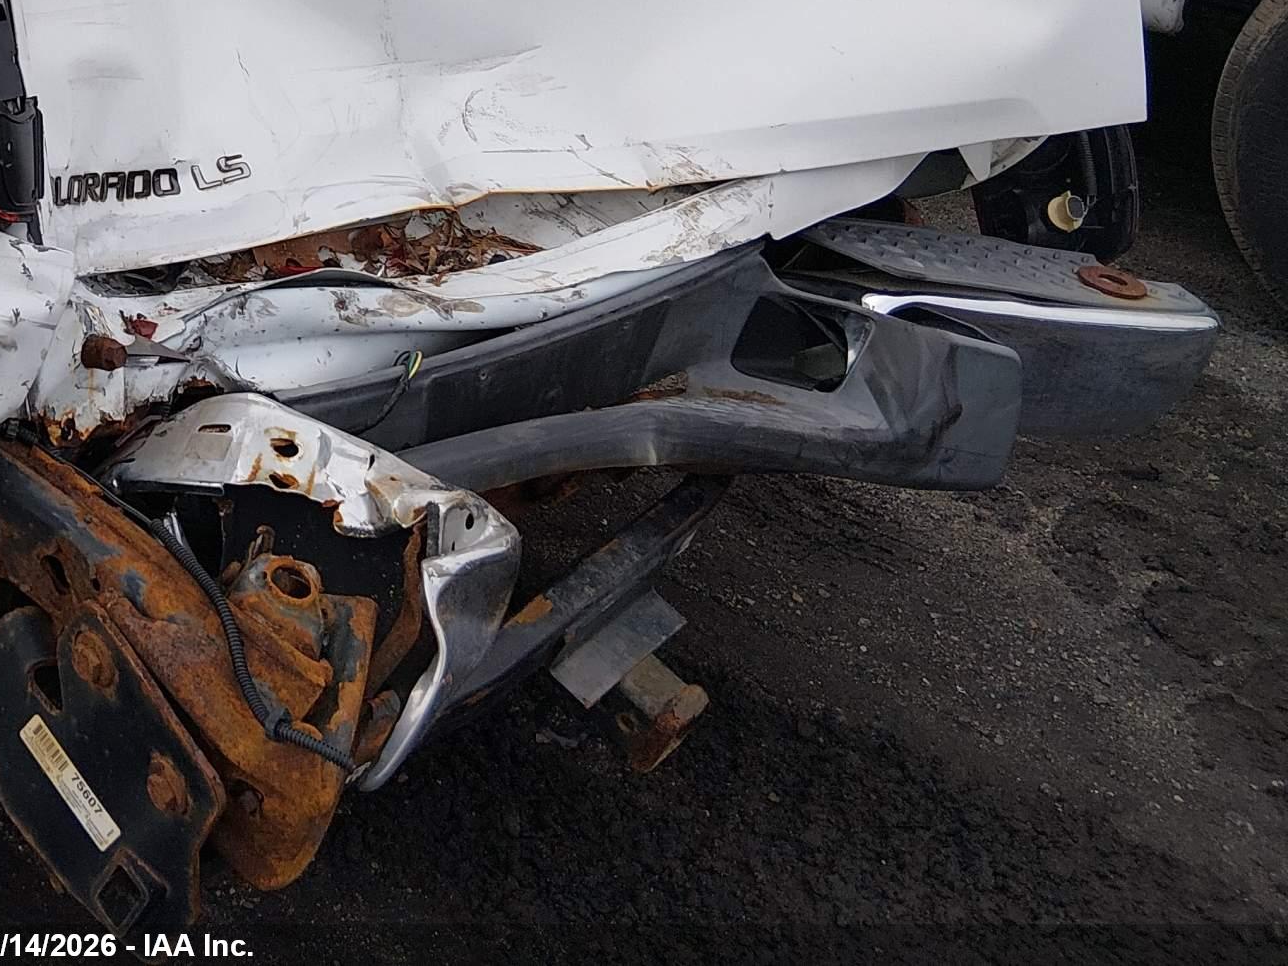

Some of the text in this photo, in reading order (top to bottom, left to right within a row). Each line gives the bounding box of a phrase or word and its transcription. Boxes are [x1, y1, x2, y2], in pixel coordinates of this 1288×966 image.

[50, 153, 253, 207] LORADO LS
[70, 772, 103, 815] 75607
